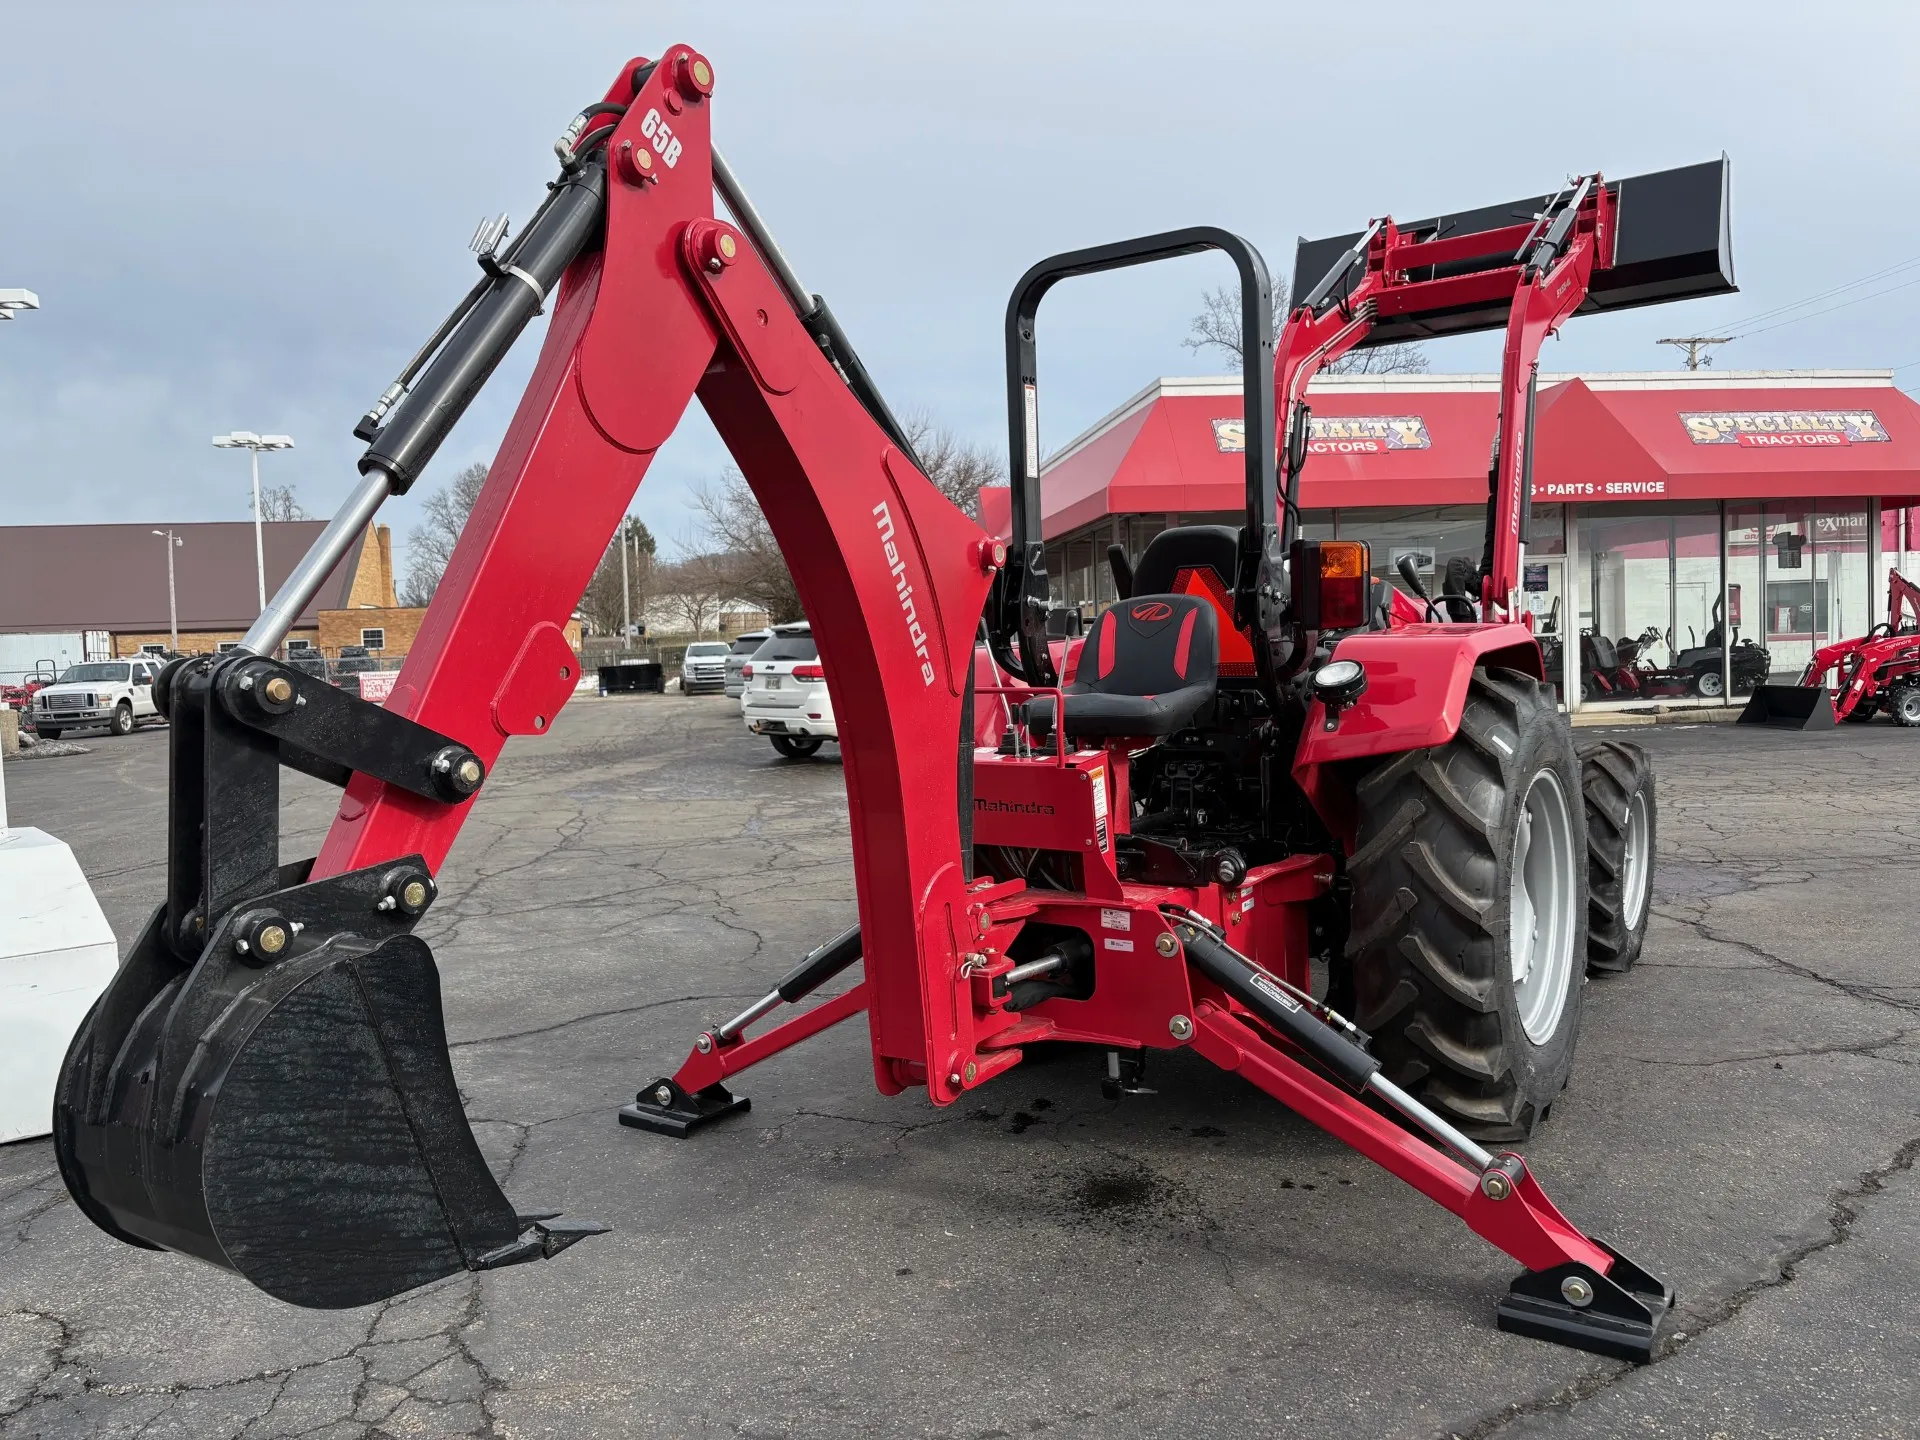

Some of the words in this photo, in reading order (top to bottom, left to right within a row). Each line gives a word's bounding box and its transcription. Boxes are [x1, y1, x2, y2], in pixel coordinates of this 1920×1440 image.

[641, 108, 683, 169] 65B
[1686, 415, 1879, 440] SPECIALTY
[1745, 434, 1841, 445] TRACTORS
[1307, 441, 1378, 453] ACTORS
[1547, 482, 1594, 495] PARTS
[1605, 481, 1665, 494] SERVICE
